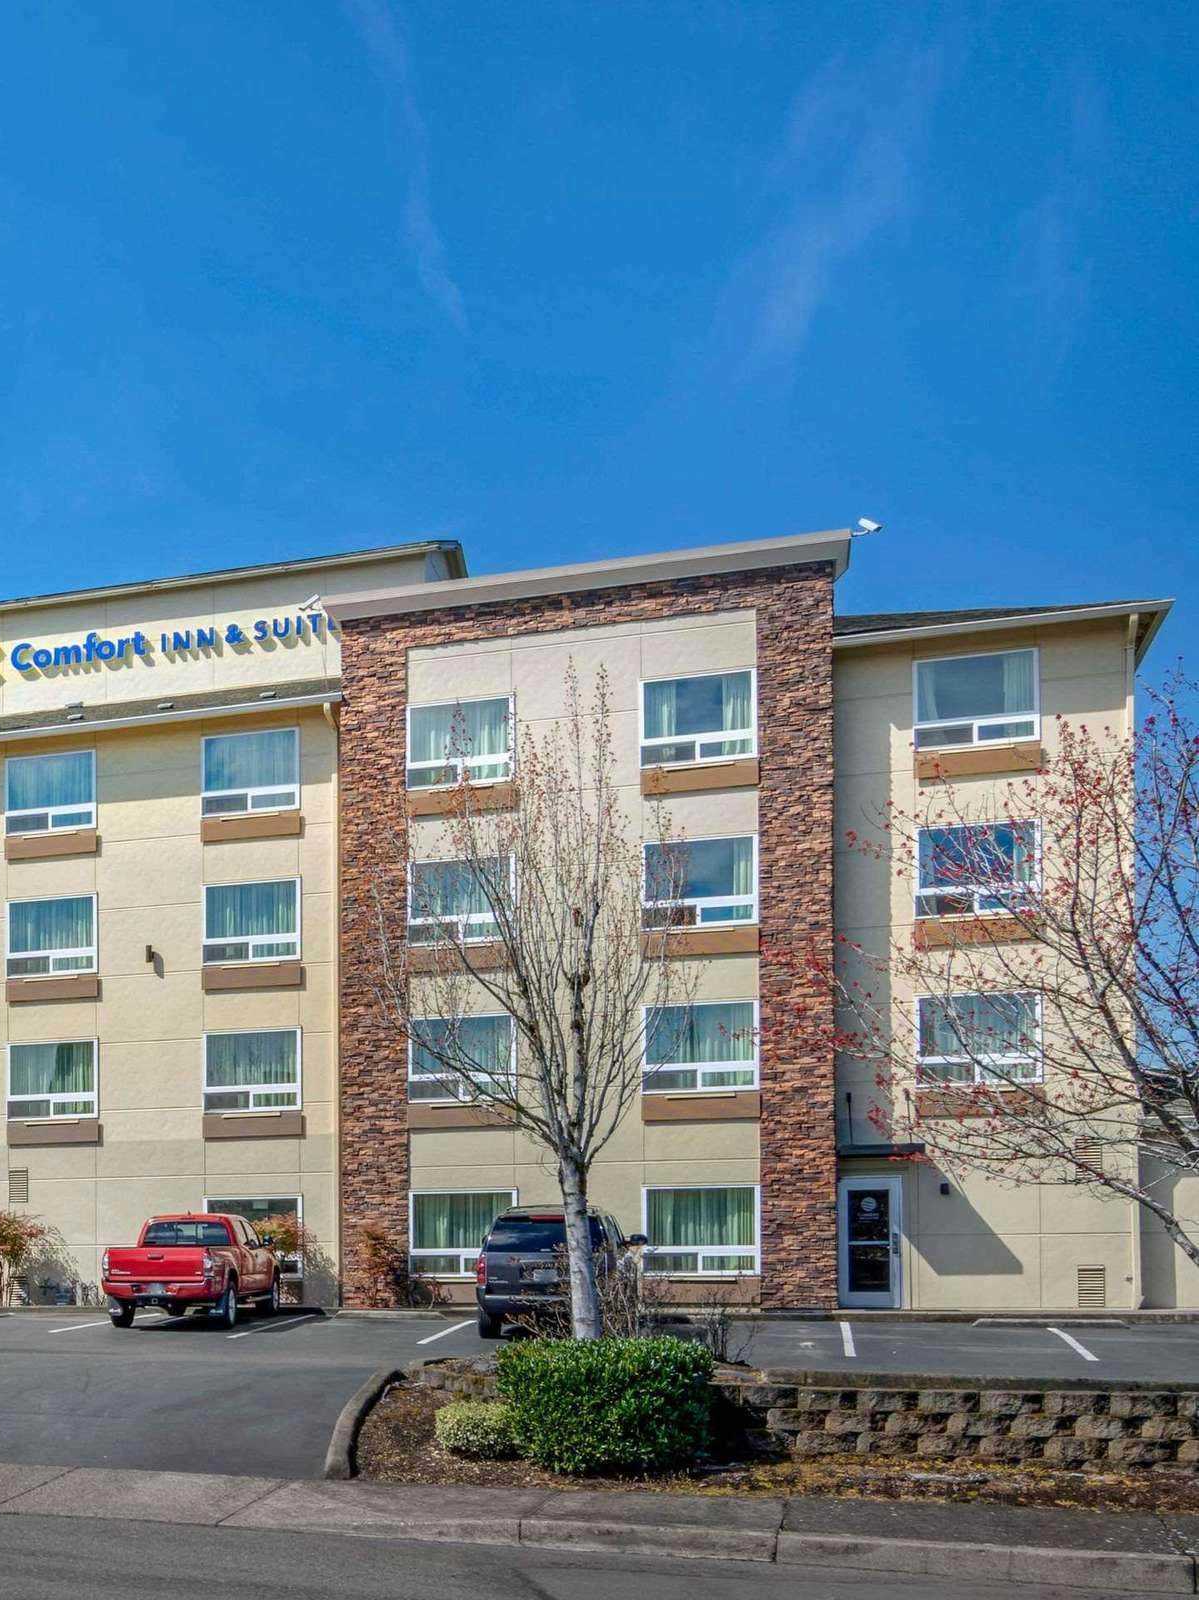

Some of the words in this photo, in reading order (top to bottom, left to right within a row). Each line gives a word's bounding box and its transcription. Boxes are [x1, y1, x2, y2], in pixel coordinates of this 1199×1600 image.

[11, 631, 146, 671] Comfort
[161, 627, 216, 653] INN
[224, 623, 243, 644] &
